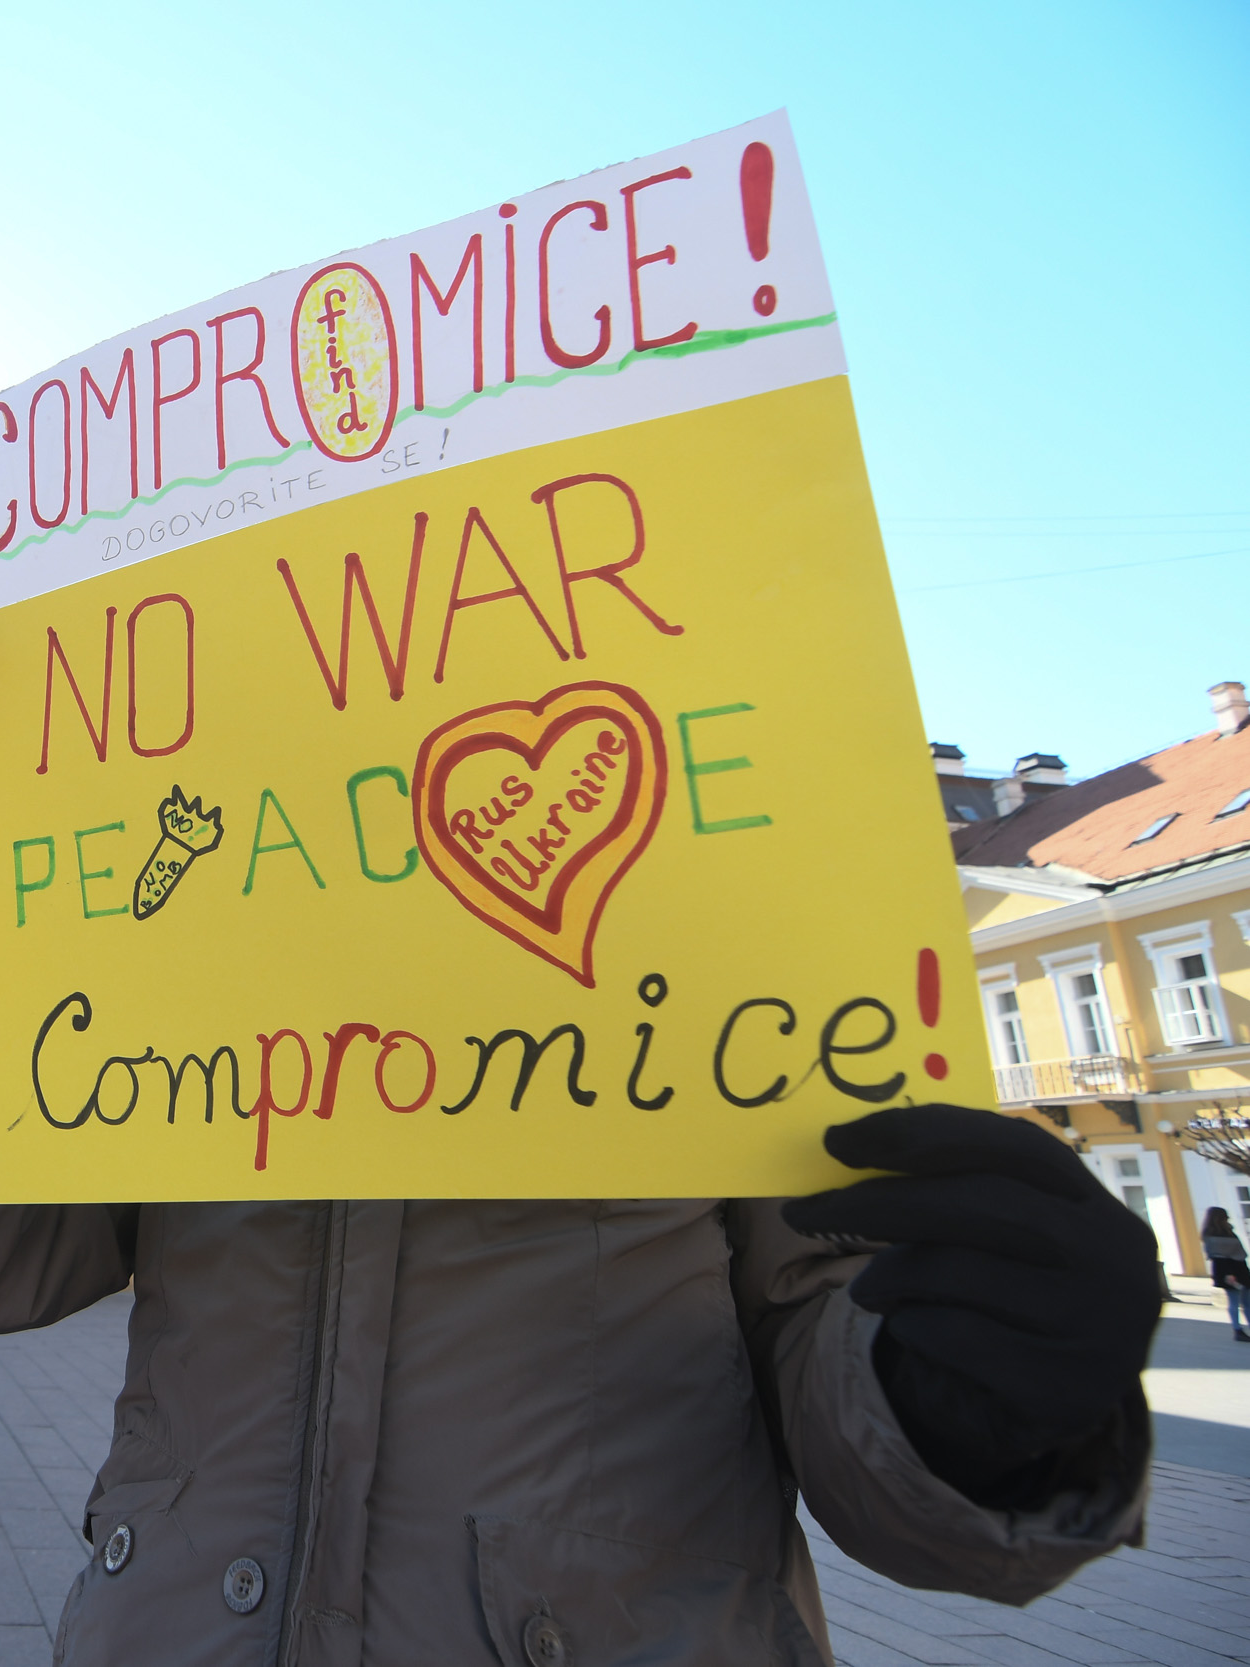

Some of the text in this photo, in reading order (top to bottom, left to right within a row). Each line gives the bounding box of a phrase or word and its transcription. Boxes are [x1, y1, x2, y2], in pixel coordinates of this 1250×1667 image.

[316, 288, 368, 435] find
[35, 472, 685, 775] NO WAR
[449, 774, 534, 854] Rus
[490, 730, 626, 892] Ukraine
